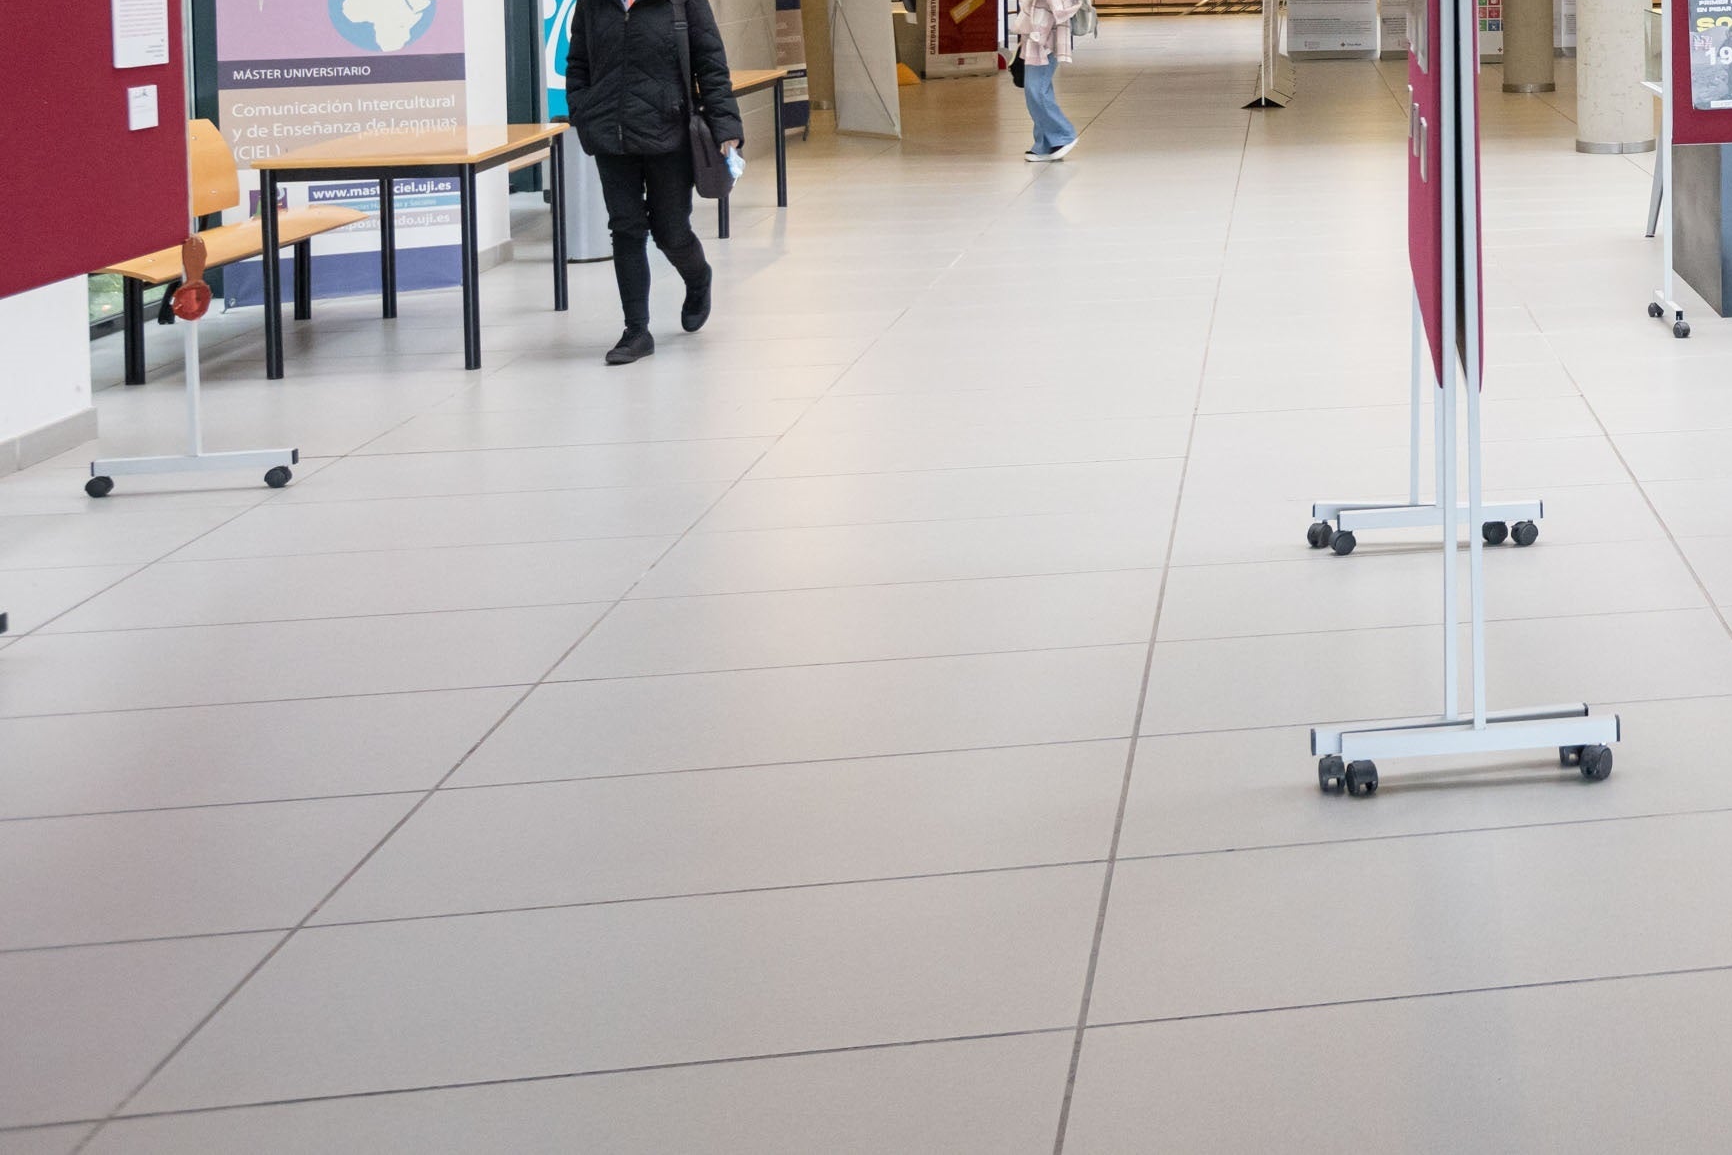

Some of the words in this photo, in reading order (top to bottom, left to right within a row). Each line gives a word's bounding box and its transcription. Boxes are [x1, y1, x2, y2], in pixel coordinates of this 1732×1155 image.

[1708, 5, 1732, 13] PISAR
[232, 67, 281, 80] MÁSTER
[283, 65, 371, 79] UNIVERSITARIO
[232, 99, 353, 118] Comunicación
[357, 94, 456, 112] Intercultural
[232, 127, 242, 142] y
[247, 124, 268, 139] de
[273, 120, 361, 138] Enseñanza
[312, 180, 452, 201] www.mastciel.uji.es
